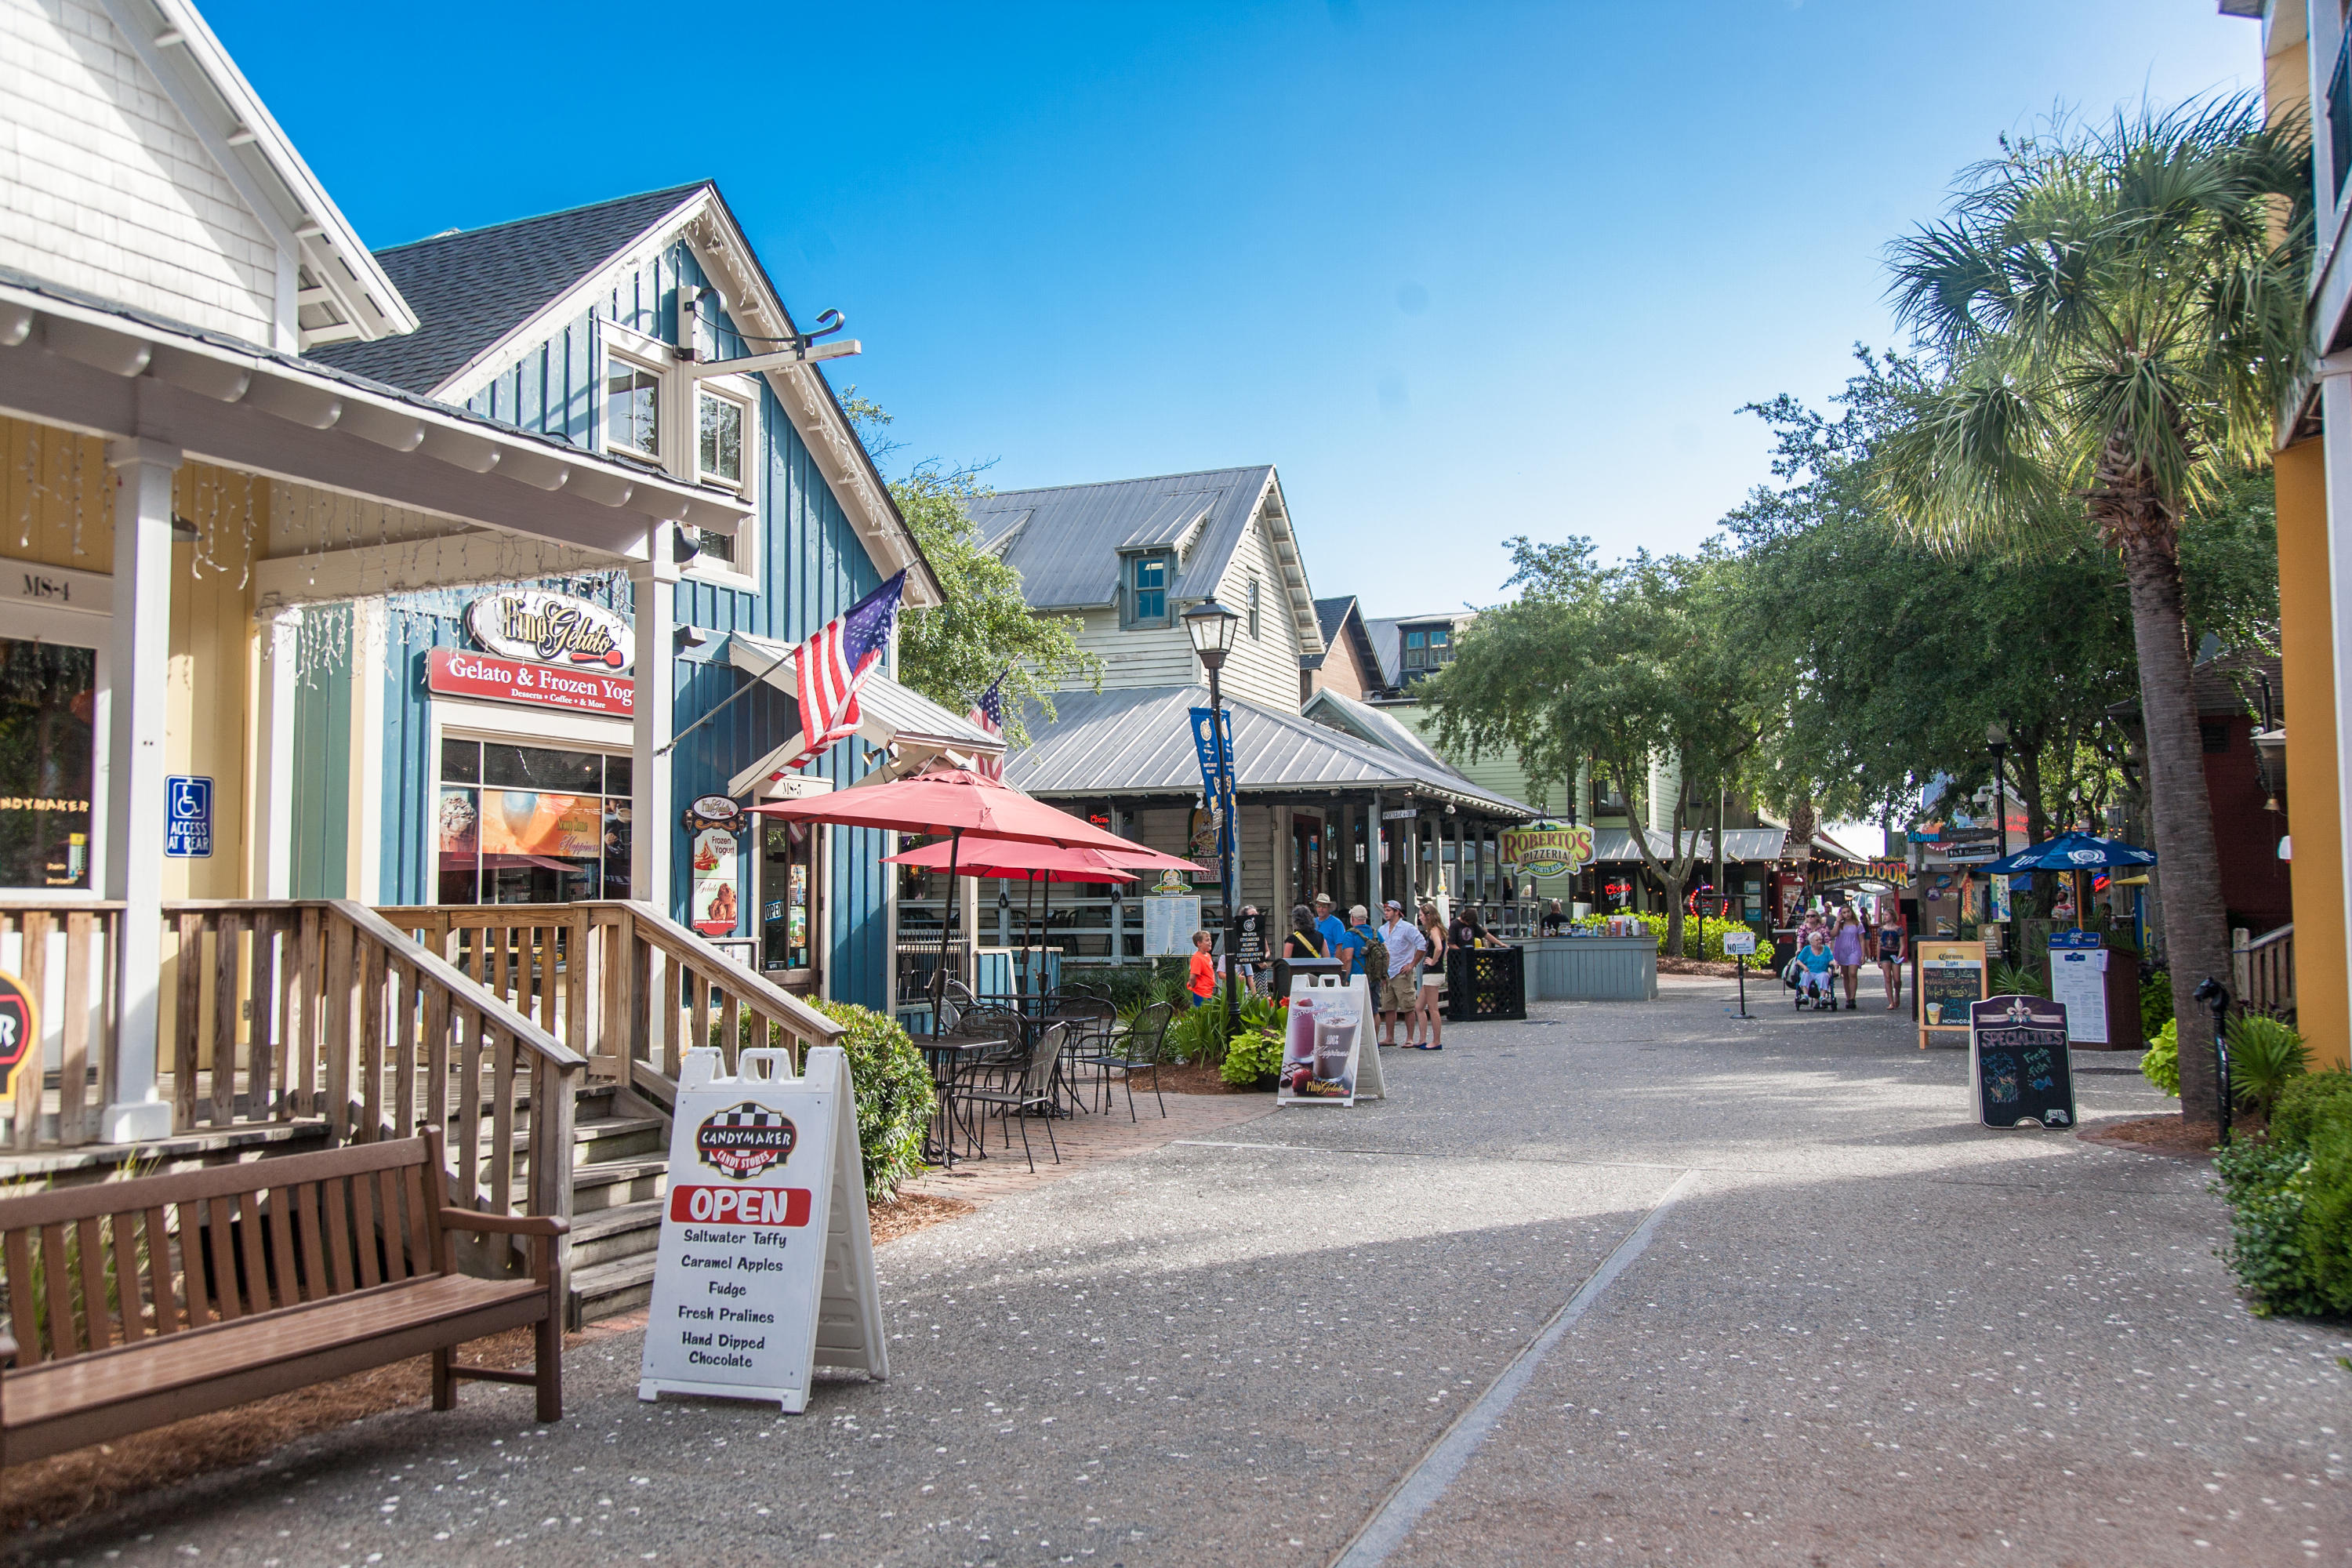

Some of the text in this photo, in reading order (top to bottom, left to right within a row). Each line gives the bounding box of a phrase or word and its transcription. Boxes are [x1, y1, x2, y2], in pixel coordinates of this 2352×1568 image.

[23, 574, 71, 602] MS-4
[503, 597, 616, 660] Pino Gelato
[449, 657, 634, 706] Gelato & Frozen Yog
[510, 688, 543, 700] Desserts
[550, 694, 573, 704] Coffee
[587, 699, 606, 709] More
[782, 782, 802, 797] MS-5
[170, 820, 207, 836] ACCESS
[168, 836, 209, 851] AT REAR
[712, 836, 731, 845] Frozen
[1501, 831, 1593, 862] ROBERTO'S
[715, 845, 735, 855] Yogurt
[1523, 848, 1568, 862] PIZZERIA
[1528, 862, 1563, 873] SPORTS BAR
[1808, 862, 1911, 889] VILLAGE DOOR
[1605, 883, 1632, 895] Coors
[765, 902, 784, 920] OPEN
[1726, 943, 1737, 953] NO
[1938, 953, 1964, 961] Corona
[1980, 1030, 2064, 1048] SPECIALTIES
[1306, 1079, 1345, 1095] Pino Gelato
[701, 1131, 791, 1146] CANDYMAKER
[717, 1149, 770, 1170] CANDY STORES
[689, 1188, 788, 1224] OPEN
[683, 1229, 787, 1248] Saltwater Taffy
[681, 1254, 783, 1272] Caramel Apples
[708, 1281, 746, 1298] Fudge
[678, 1305, 775, 1325] Fresh Pralines
[681, 1331, 765, 1350] Hand Dipped
[688, 1351, 753, 1368] Chocolate
